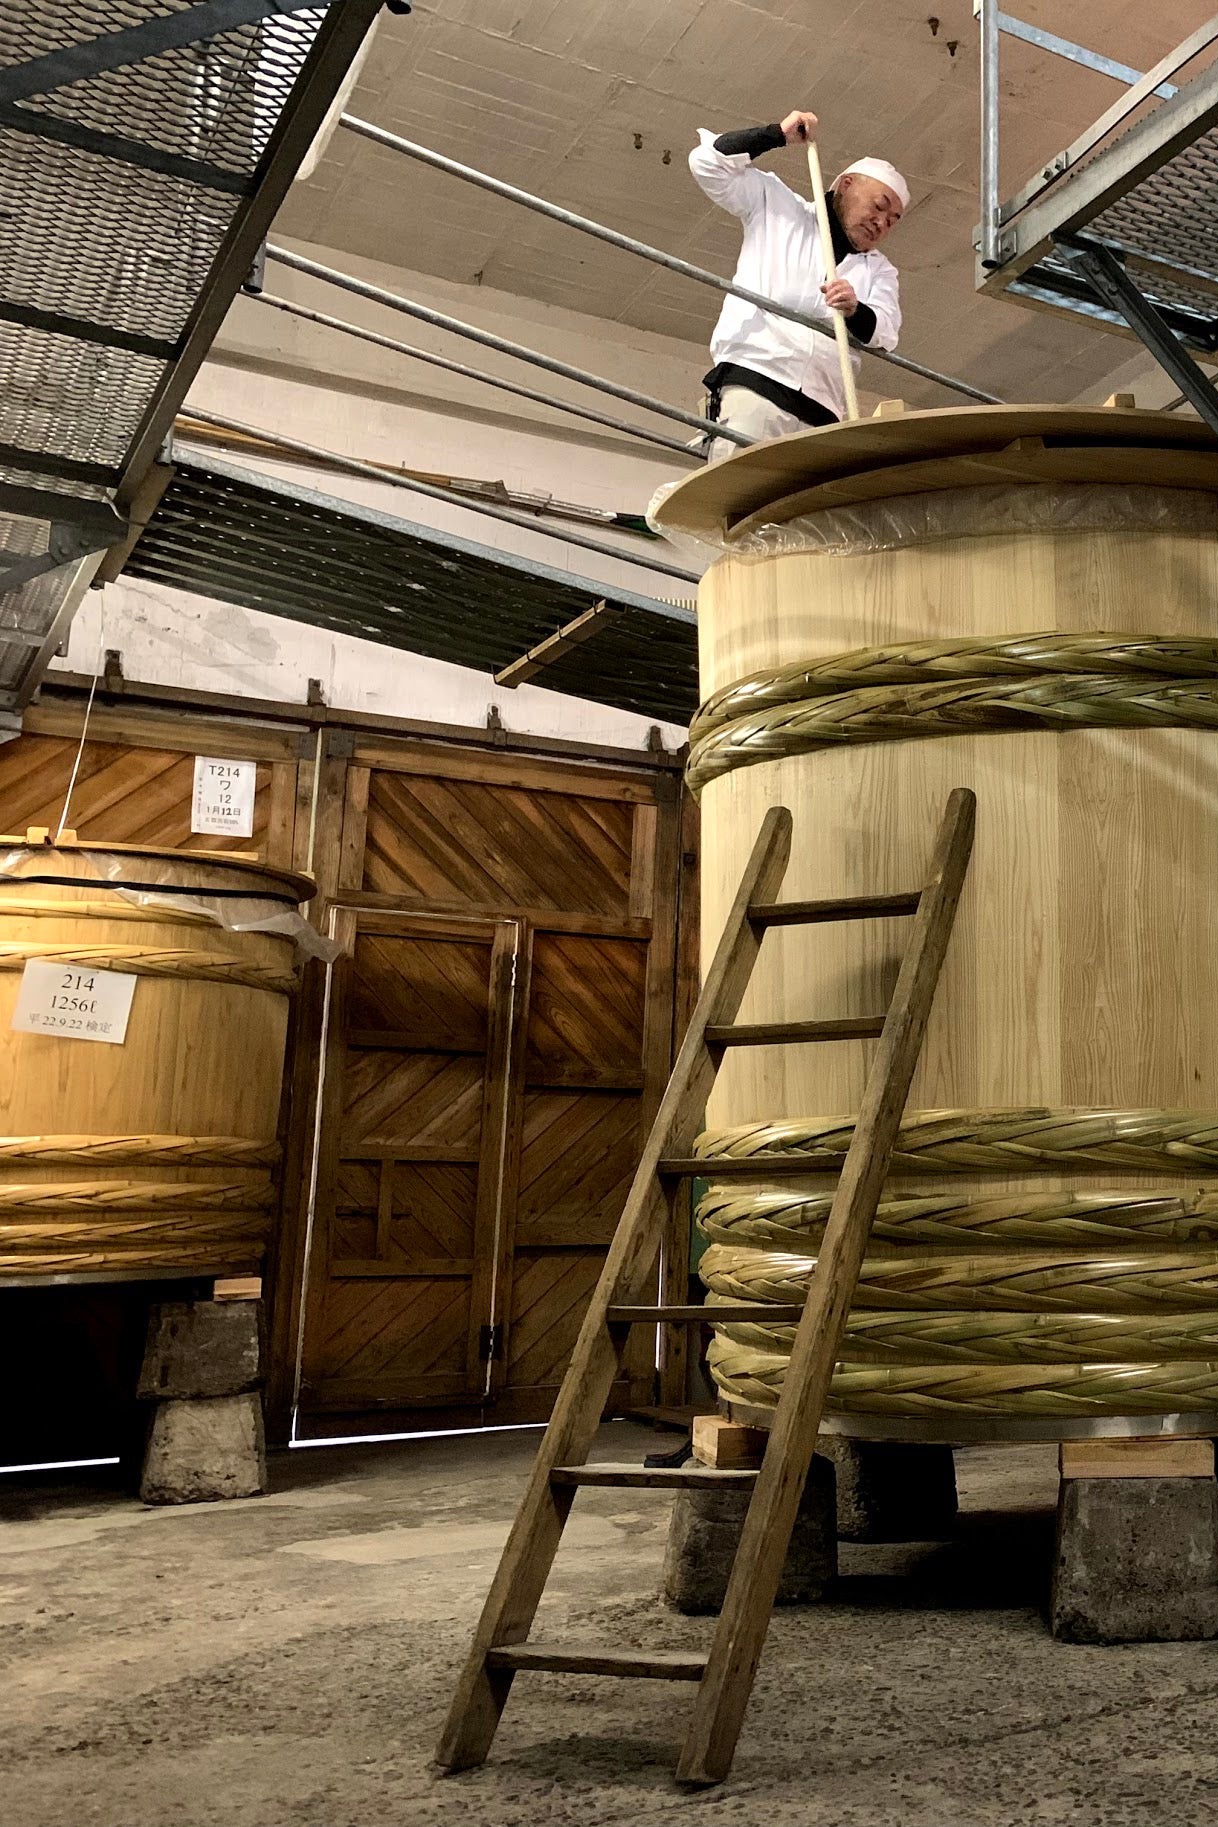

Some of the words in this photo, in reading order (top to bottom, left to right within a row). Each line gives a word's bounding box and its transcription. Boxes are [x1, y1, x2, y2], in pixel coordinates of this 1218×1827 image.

[208, 764, 240, 778] T214
[219, 780, 231, 791] ワ
[219, 794, 232, 804] 12
[61, 973, 95, 992] 214
